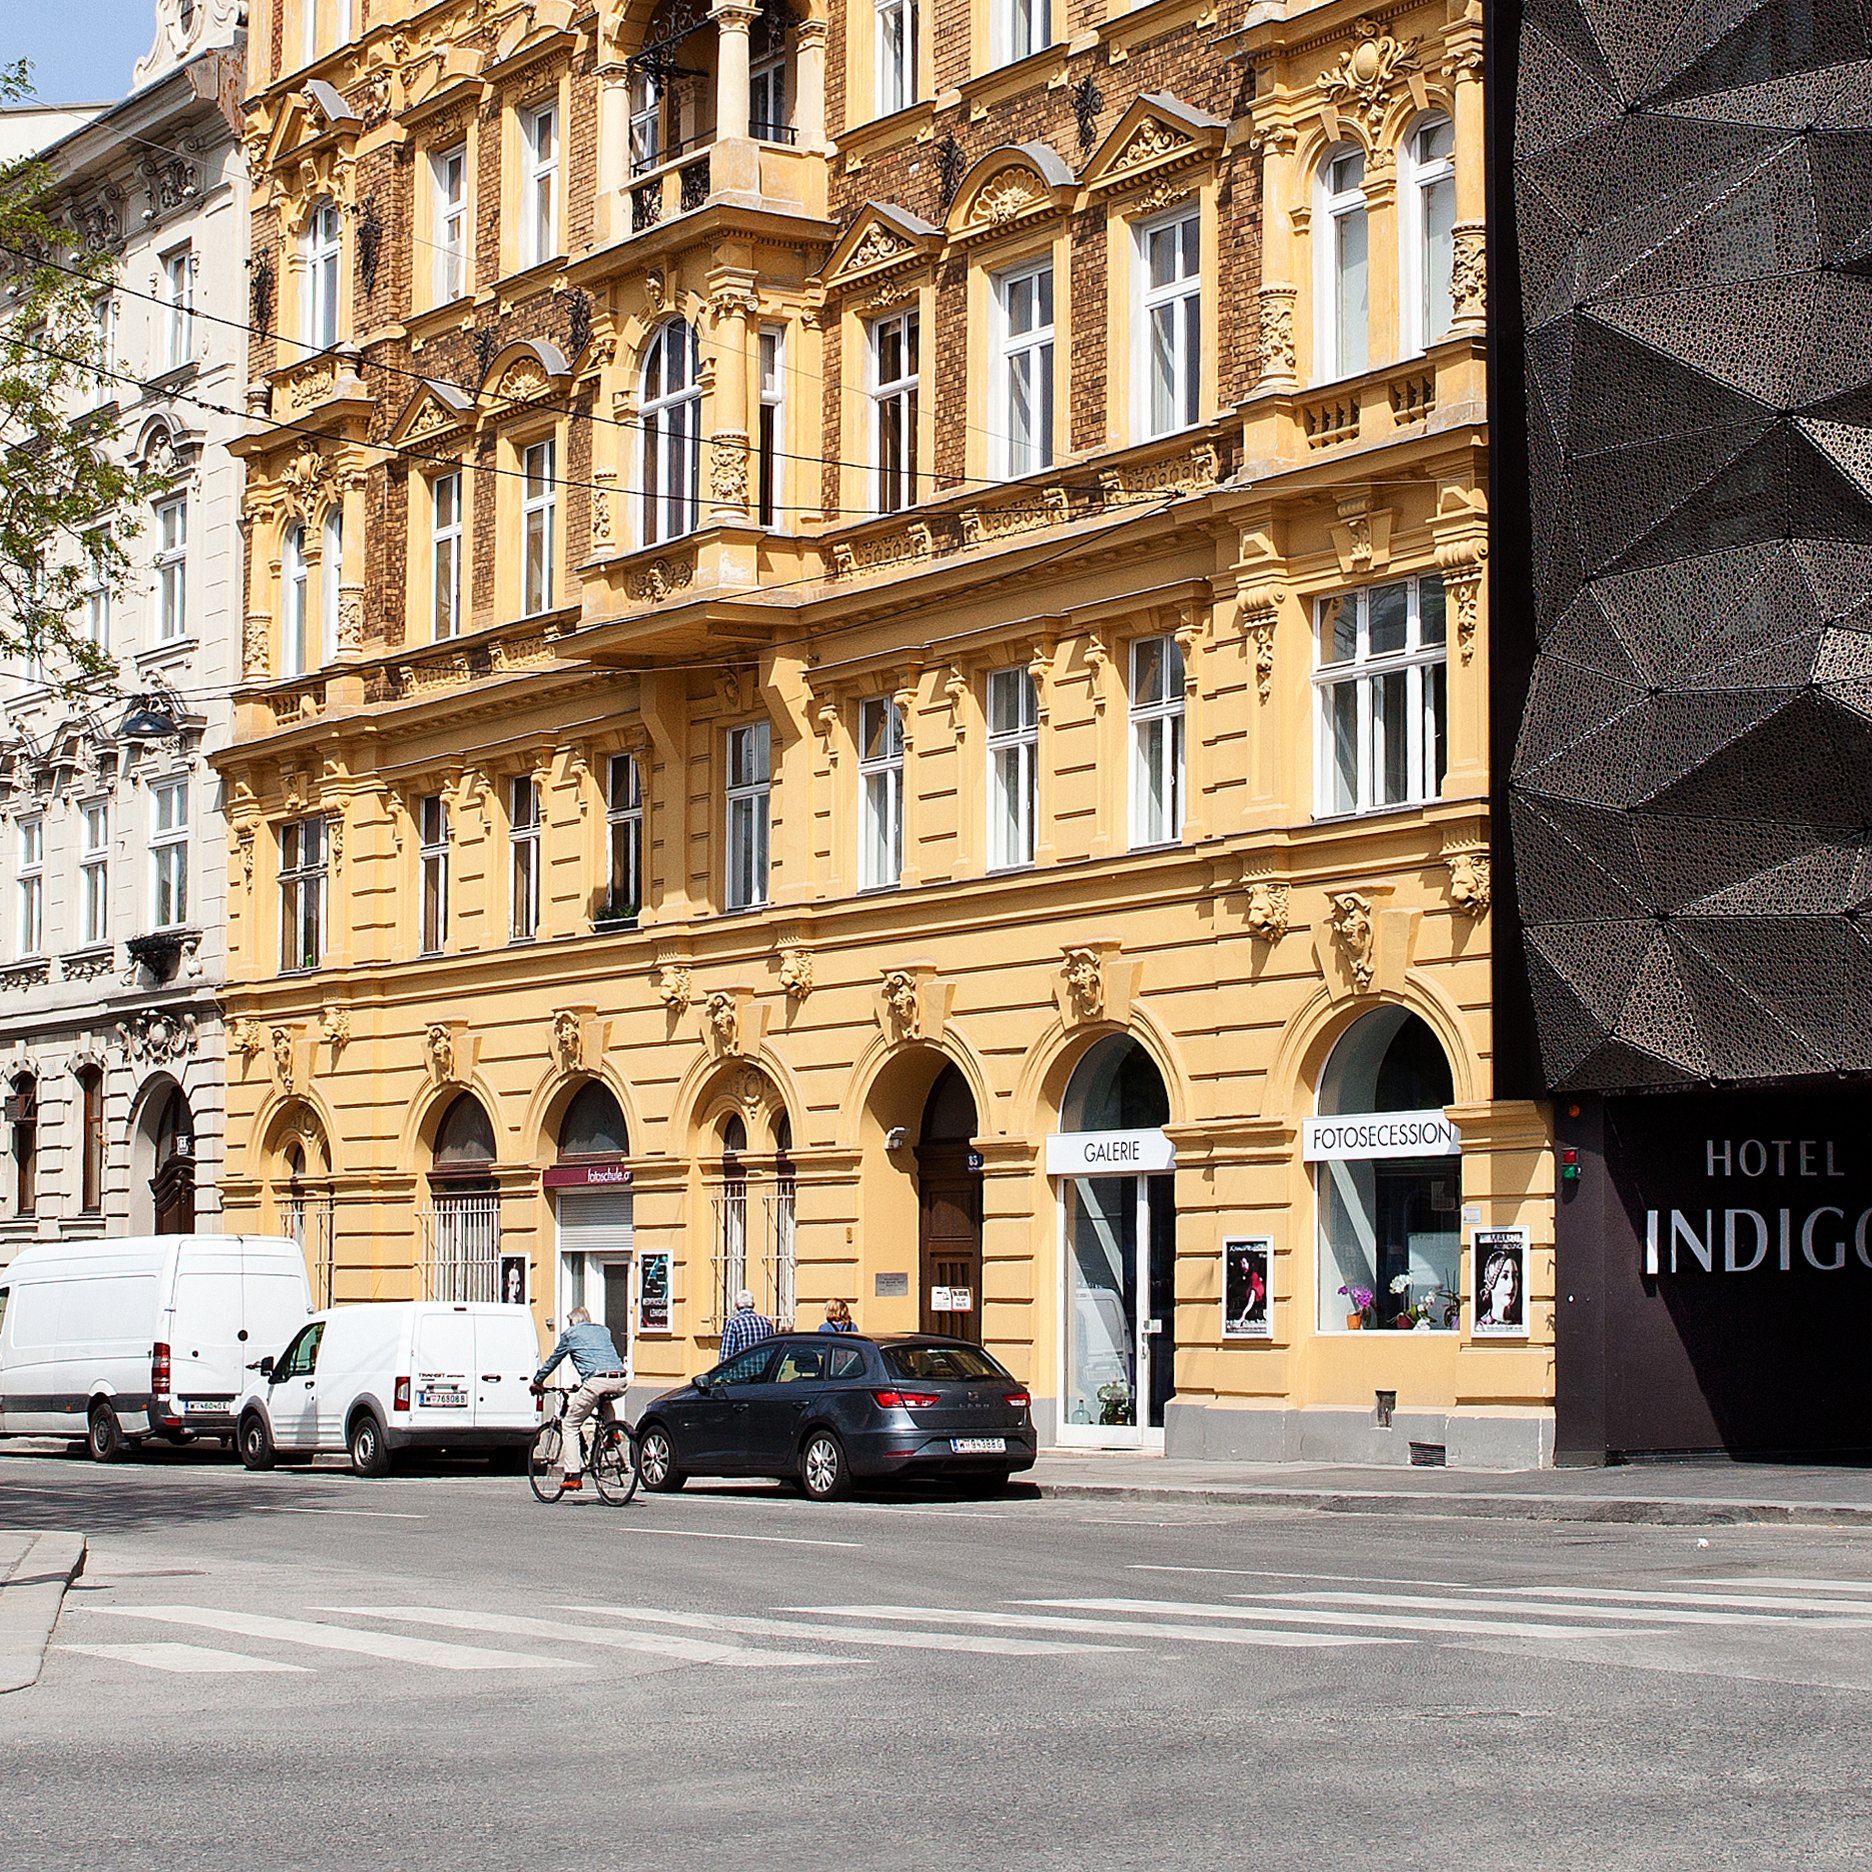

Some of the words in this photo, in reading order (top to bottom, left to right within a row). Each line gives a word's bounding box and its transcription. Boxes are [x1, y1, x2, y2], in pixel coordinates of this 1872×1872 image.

[1313, 1121, 1452, 1149] FOTOSECESSION
[1083, 1139, 1140, 1163] GALERIE
[1706, 1139, 1845, 1176] HOTEL
[587, 1168, 631, 1183] fotoschule.a
